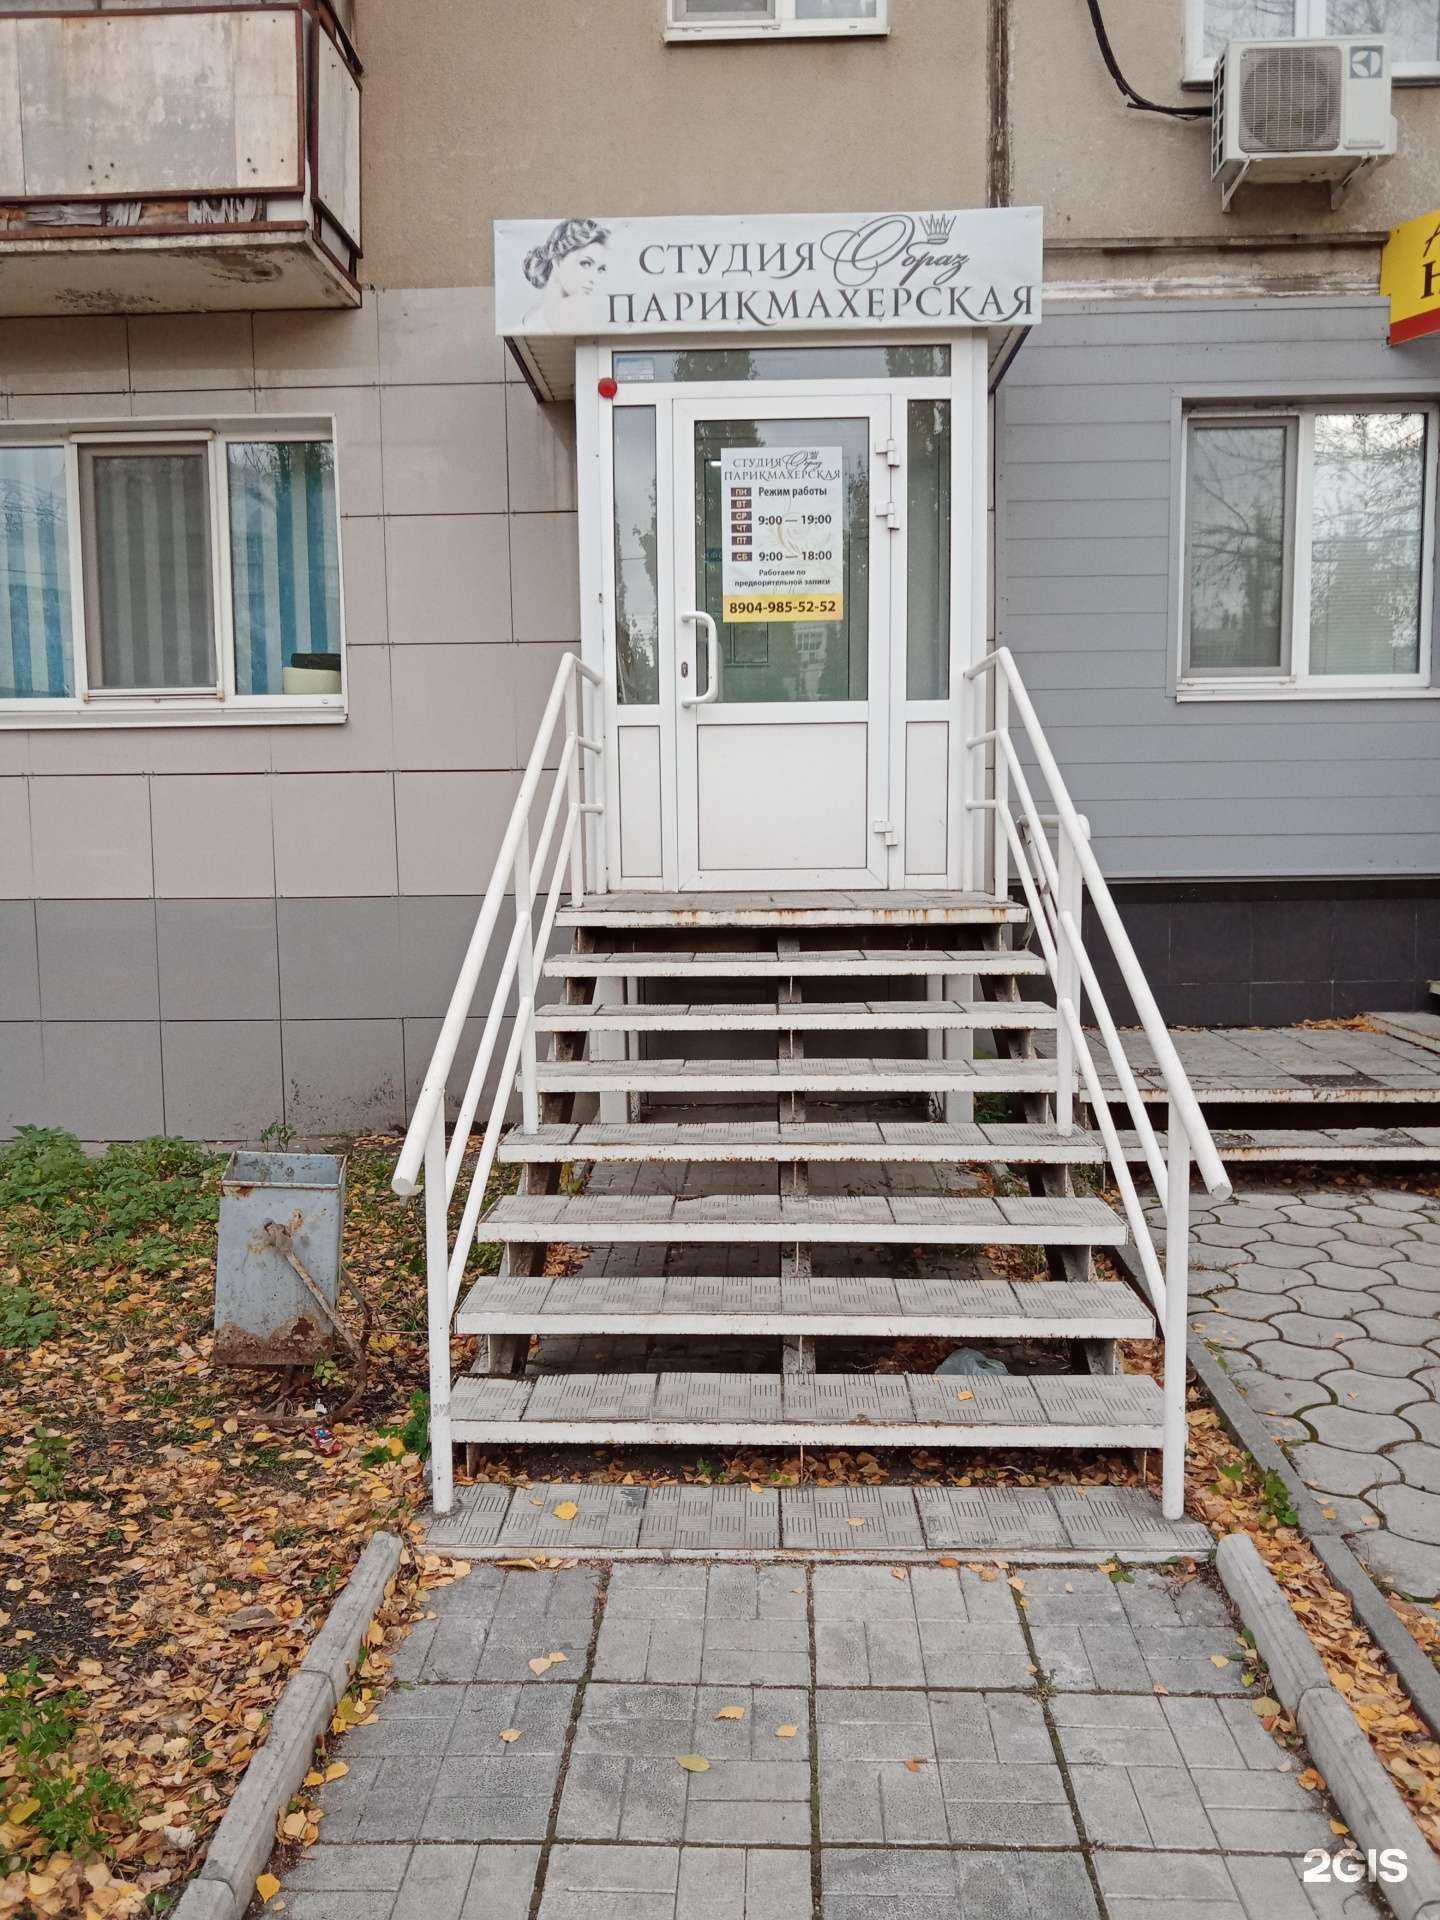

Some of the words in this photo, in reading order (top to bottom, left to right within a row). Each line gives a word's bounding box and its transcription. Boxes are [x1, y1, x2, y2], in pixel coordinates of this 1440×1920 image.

[638, 242, 815, 279] СТУДИЯ
[820, 214, 970, 287] Образ
[608, 285, 1034, 326] ПАРИКМАХЕРСКАЯ
[732, 457, 782, 469] СТУДИЯ
[724, 470, 840, 481] ПАРИКМАХЕРСКАЯ
[735, 488, 748, 497] ПН
[758, 486, 790, 496] Режим
[792, 486, 827, 498] работы
[736, 500, 747, 509] ВТ
[758, 515, 783, 526] 9:00
[801, 514, 832, 525] 19:00
[736, 525, 747, 533] ЧТ
[736, 537, 747, 545] ПТ
[736, 553, 749, 561] СБ
[758, 551, 783, 562] 9:00
[802, 550, 832, 561] 18:00
[729, 601, 836, 614] 8904-985-52-52
